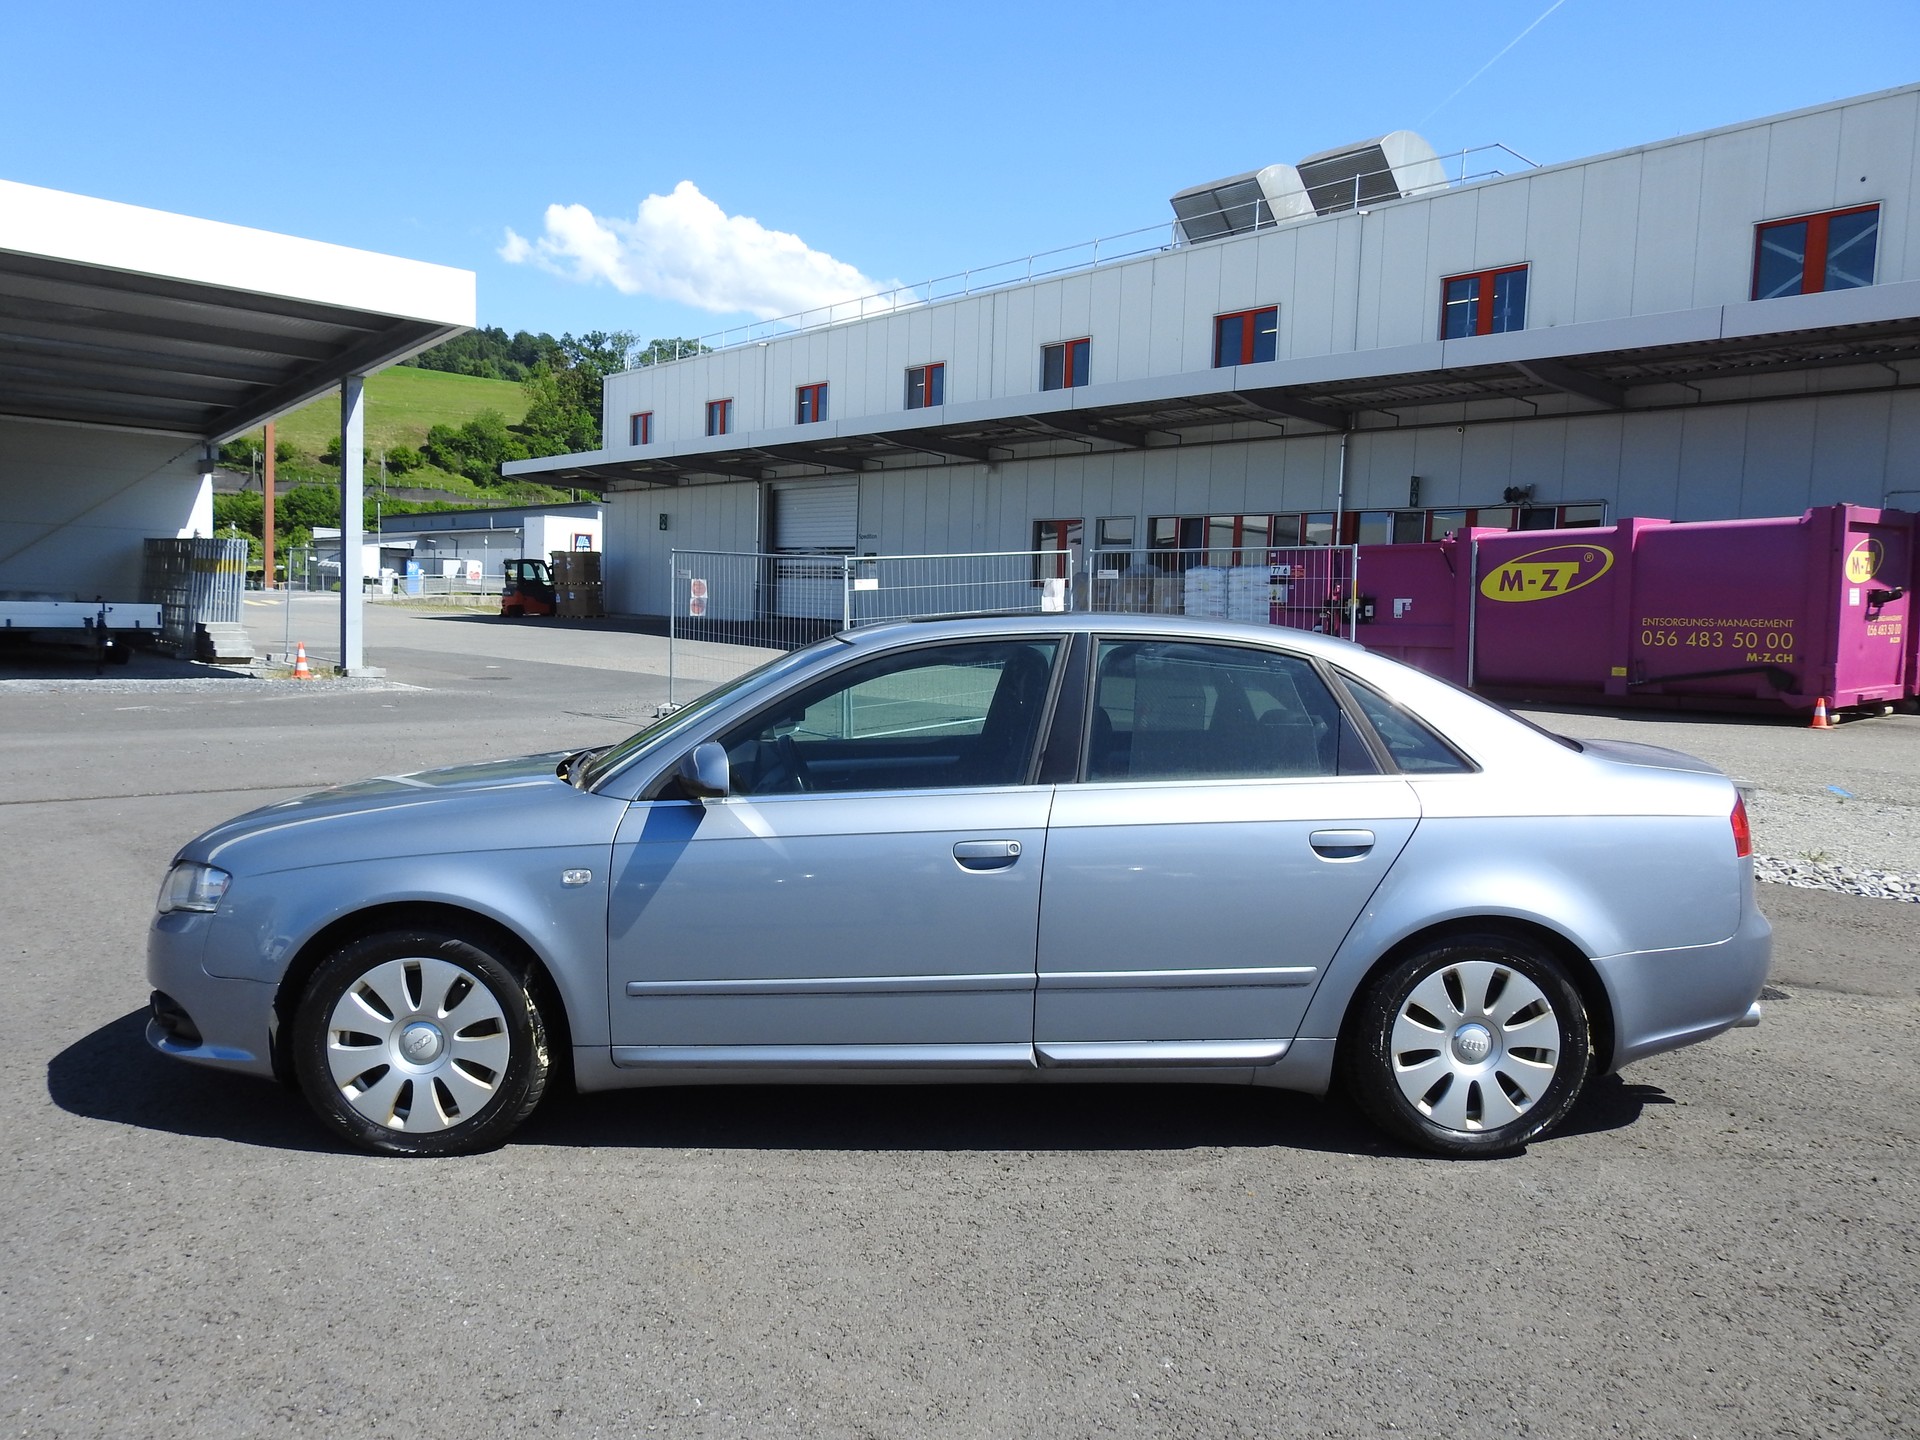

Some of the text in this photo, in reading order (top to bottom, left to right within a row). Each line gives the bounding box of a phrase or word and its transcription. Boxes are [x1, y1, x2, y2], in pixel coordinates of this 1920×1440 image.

[1642, 617, 1794, 628] ENTSORGUNGS-MANAGEMENT
[1641, 630, 1794, 649] 056 483 50 00
[1746, 653, 1793, 663] M-Z.CH
